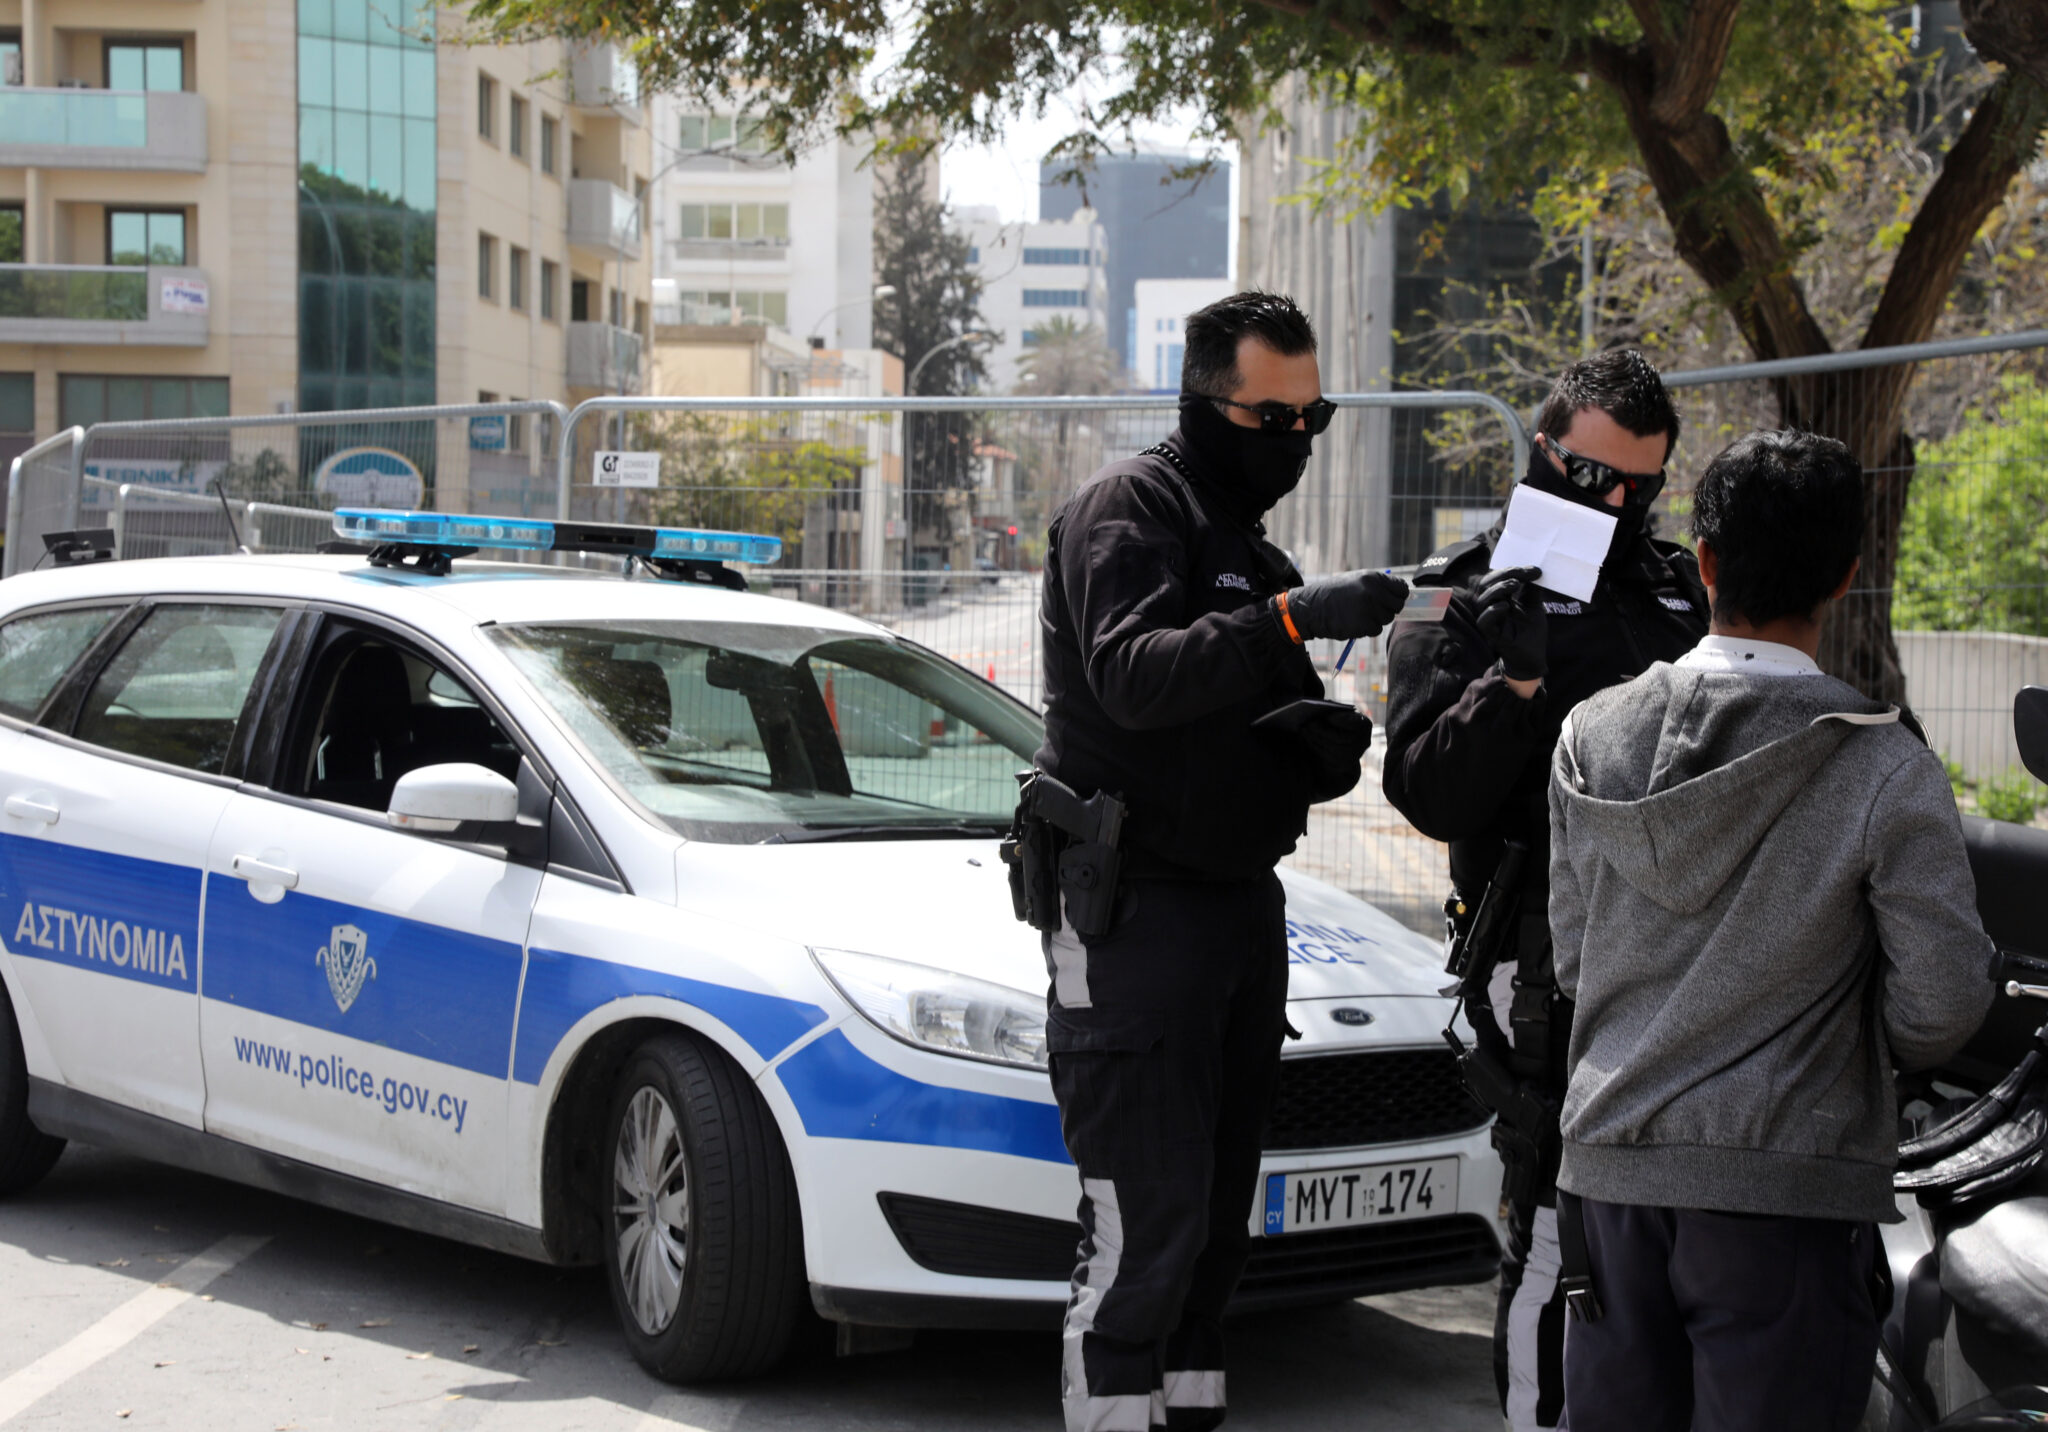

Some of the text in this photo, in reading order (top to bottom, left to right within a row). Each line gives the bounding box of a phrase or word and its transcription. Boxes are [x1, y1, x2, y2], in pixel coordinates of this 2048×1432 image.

[14, 902, 187, 980] ΑΣΤΥΝΟΜΙΑ
[233, 1036, 468, 1134] www.police.gov.cy
[1266, 1211, 1283, 1225] CY
[1296, 1167, 1433, 1224] MYT 174
